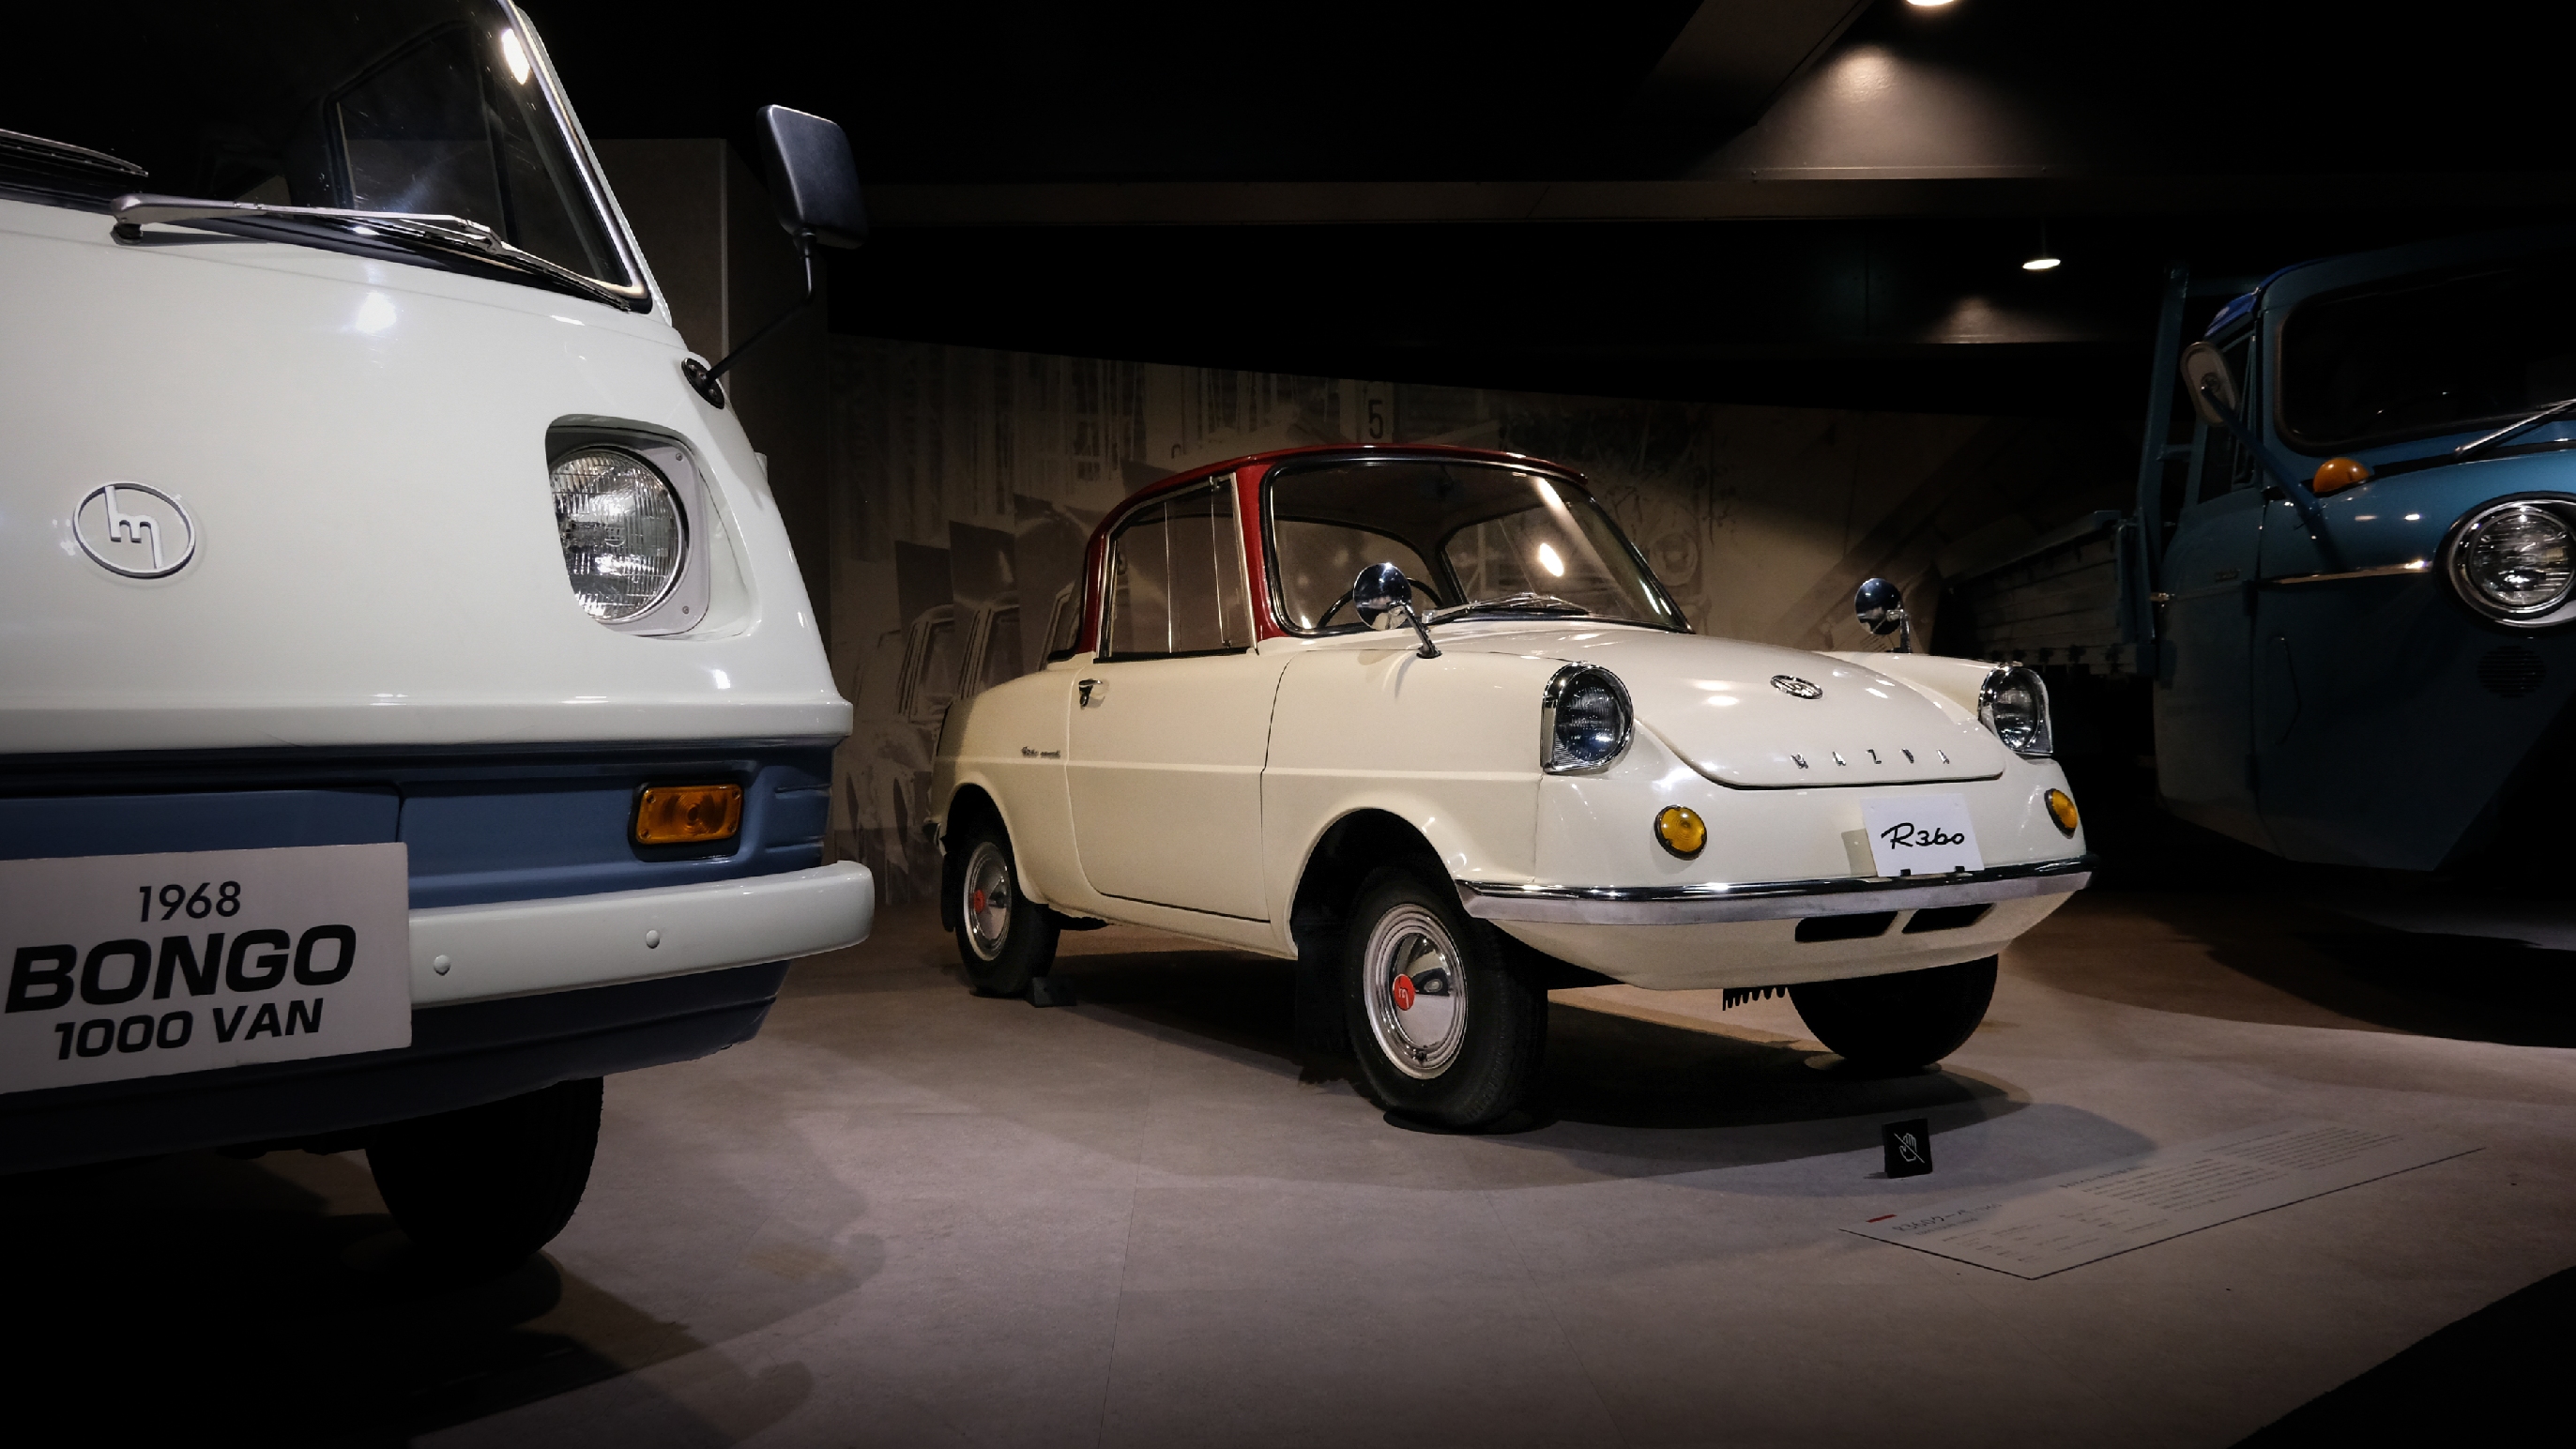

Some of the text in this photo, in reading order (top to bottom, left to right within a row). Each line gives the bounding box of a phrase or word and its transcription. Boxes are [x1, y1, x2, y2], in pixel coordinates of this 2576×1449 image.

[1368, 399, 1384, 439] 5
[1790, 748, 1950, 770] MAZDA
[1881, 822, 1965, 849] R360
[139, 880, 241, 923] 1968
[5, 923, 357, 1014] BONGO
[54, 998, 324, 1060] 1000 VAN
